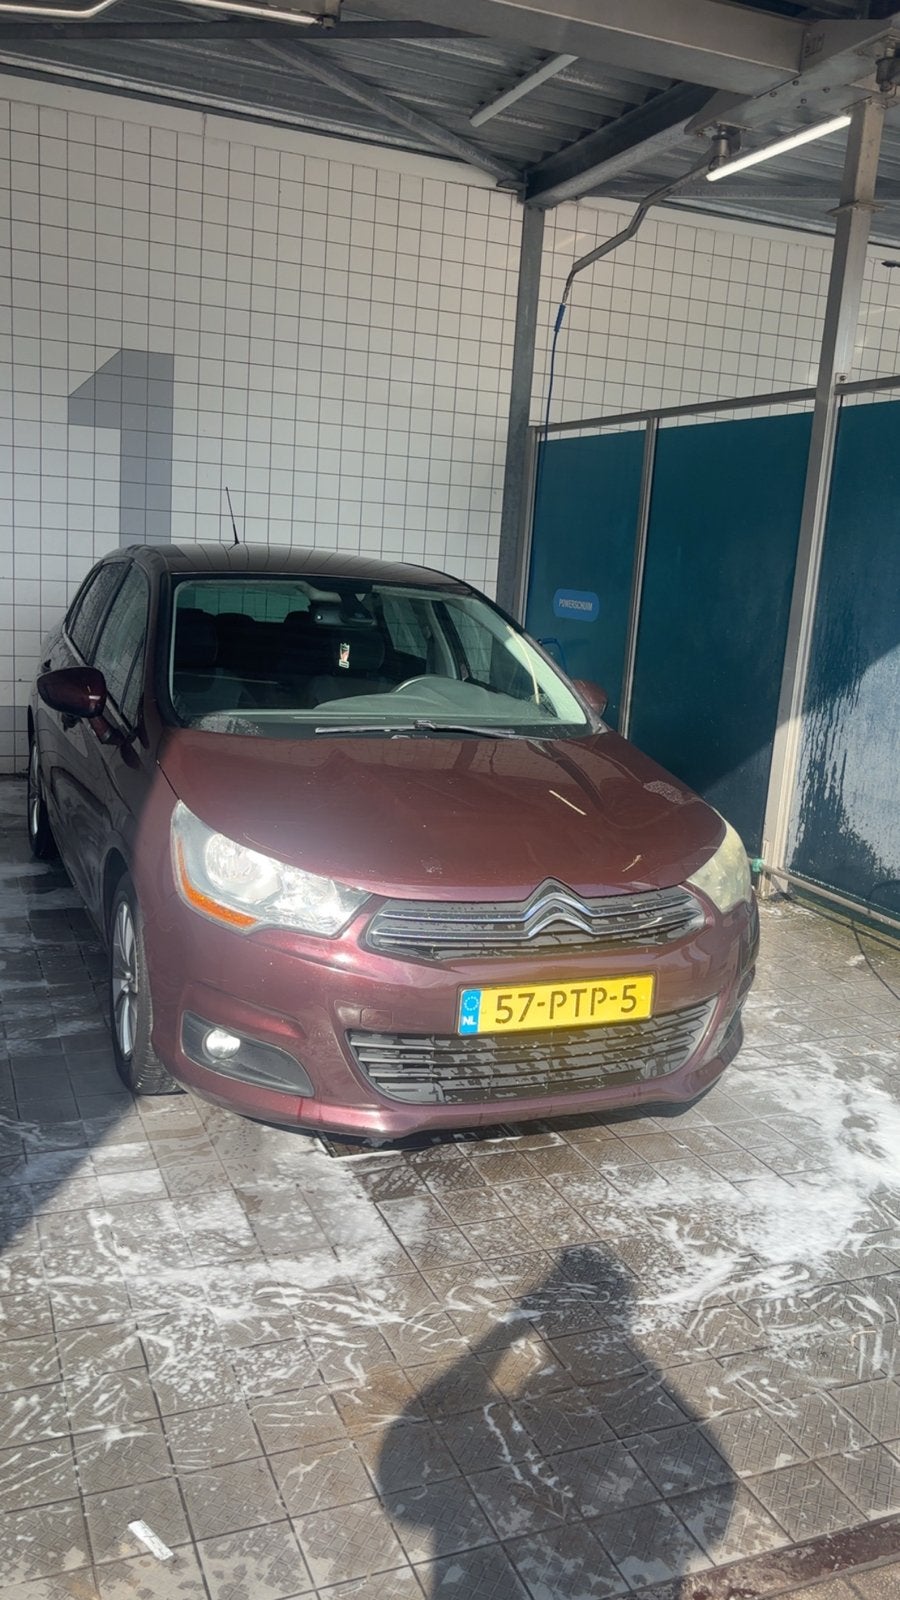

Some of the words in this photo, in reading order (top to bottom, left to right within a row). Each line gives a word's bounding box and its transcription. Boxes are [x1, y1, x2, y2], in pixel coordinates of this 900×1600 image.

[68, 349, 174, 545] 1
[462, 1016, 476, 1025] NL
[495, 984, 637, 1024] 57-PTP-5
